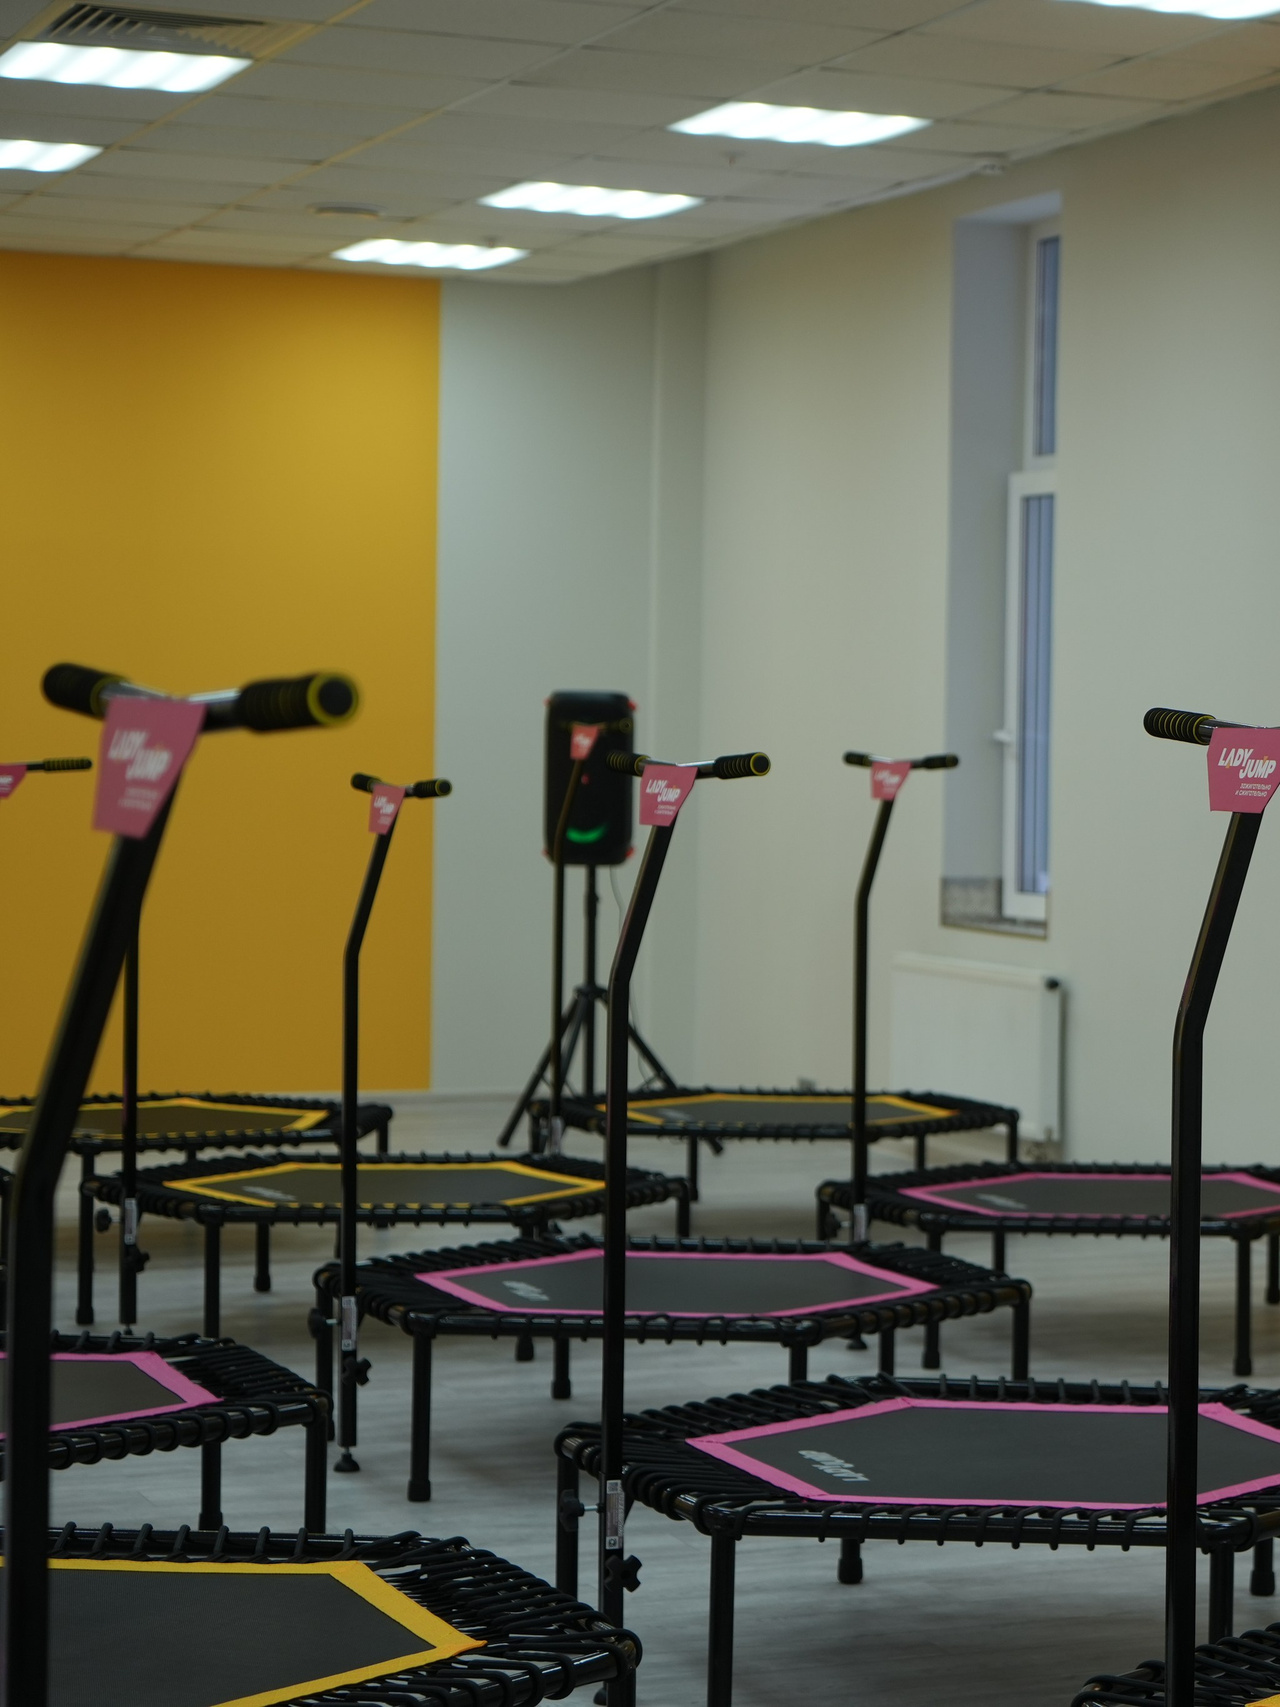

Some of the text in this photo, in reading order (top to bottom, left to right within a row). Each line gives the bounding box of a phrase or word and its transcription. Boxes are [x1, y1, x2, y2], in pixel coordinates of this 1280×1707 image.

[1217, 748, 1254, 768] LADY
[1239, 756, 1277, 779] JUMP
[645, 779, 668, 794] LADY
[657, 785, 681, 803] JUMP
